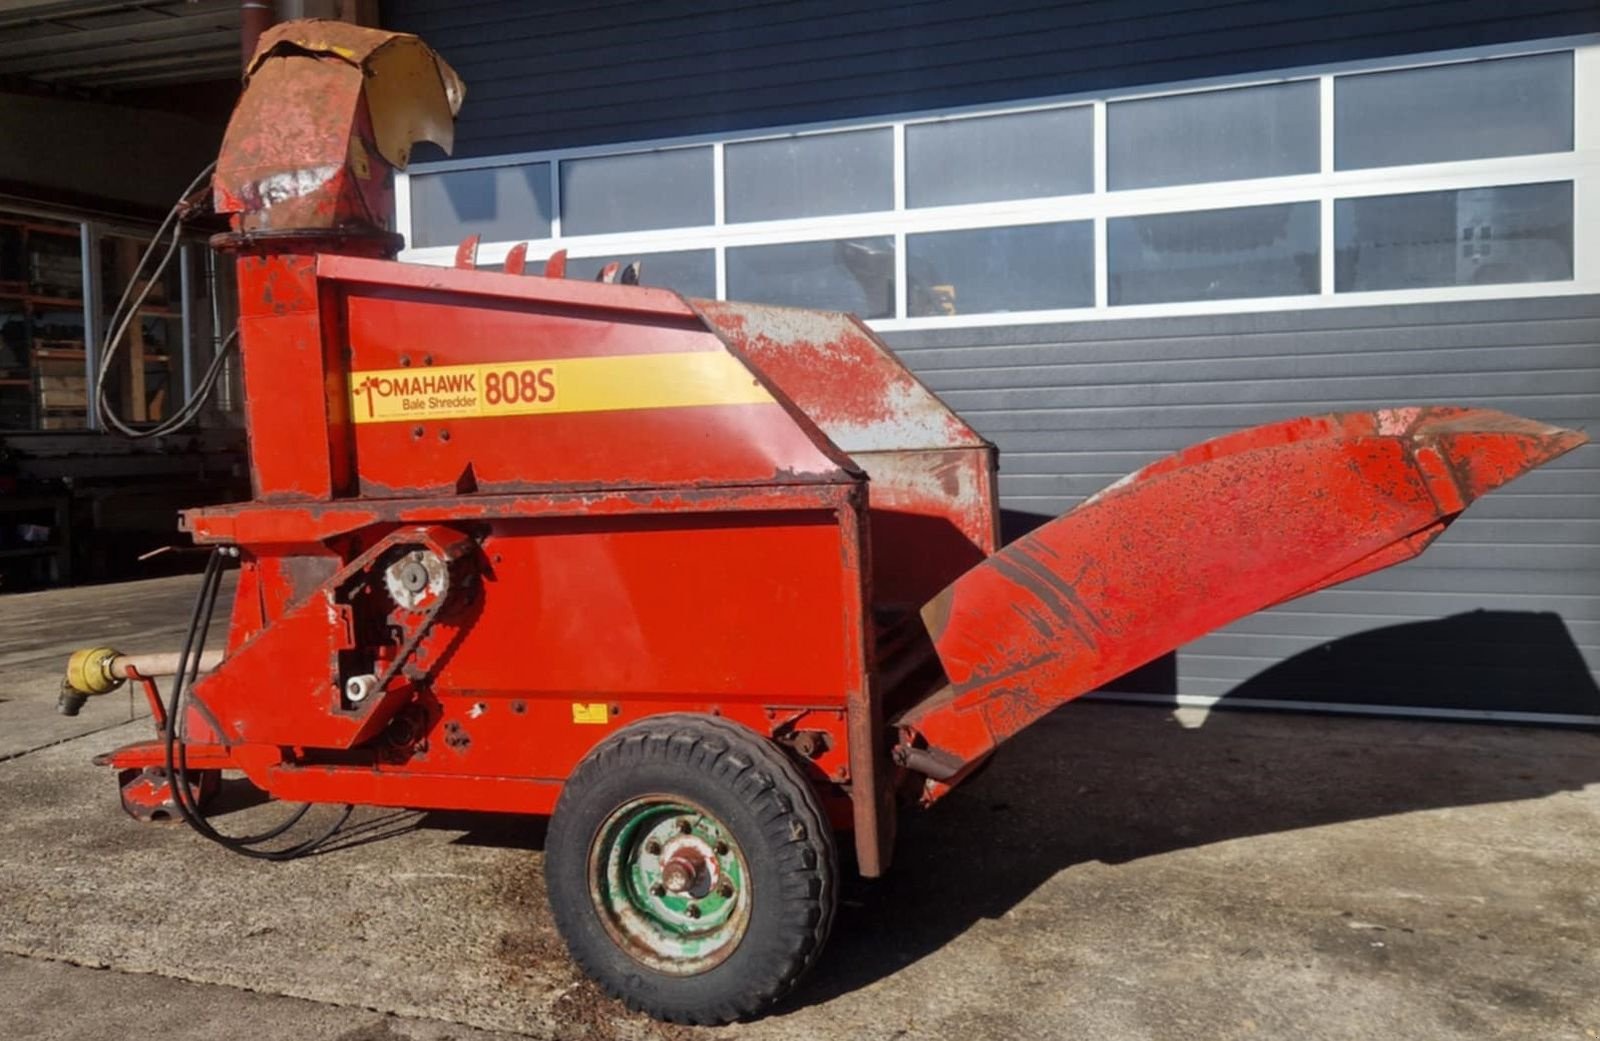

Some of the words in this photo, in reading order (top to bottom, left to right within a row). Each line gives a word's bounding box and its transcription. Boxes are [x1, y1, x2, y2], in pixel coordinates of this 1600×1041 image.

[353, 374, 476, 418] TOMAHAWK
[402, 398, 426, 411] Bale
[428, 396, 477, 410] Shredder
[485, 368, 555, 405] 808S
